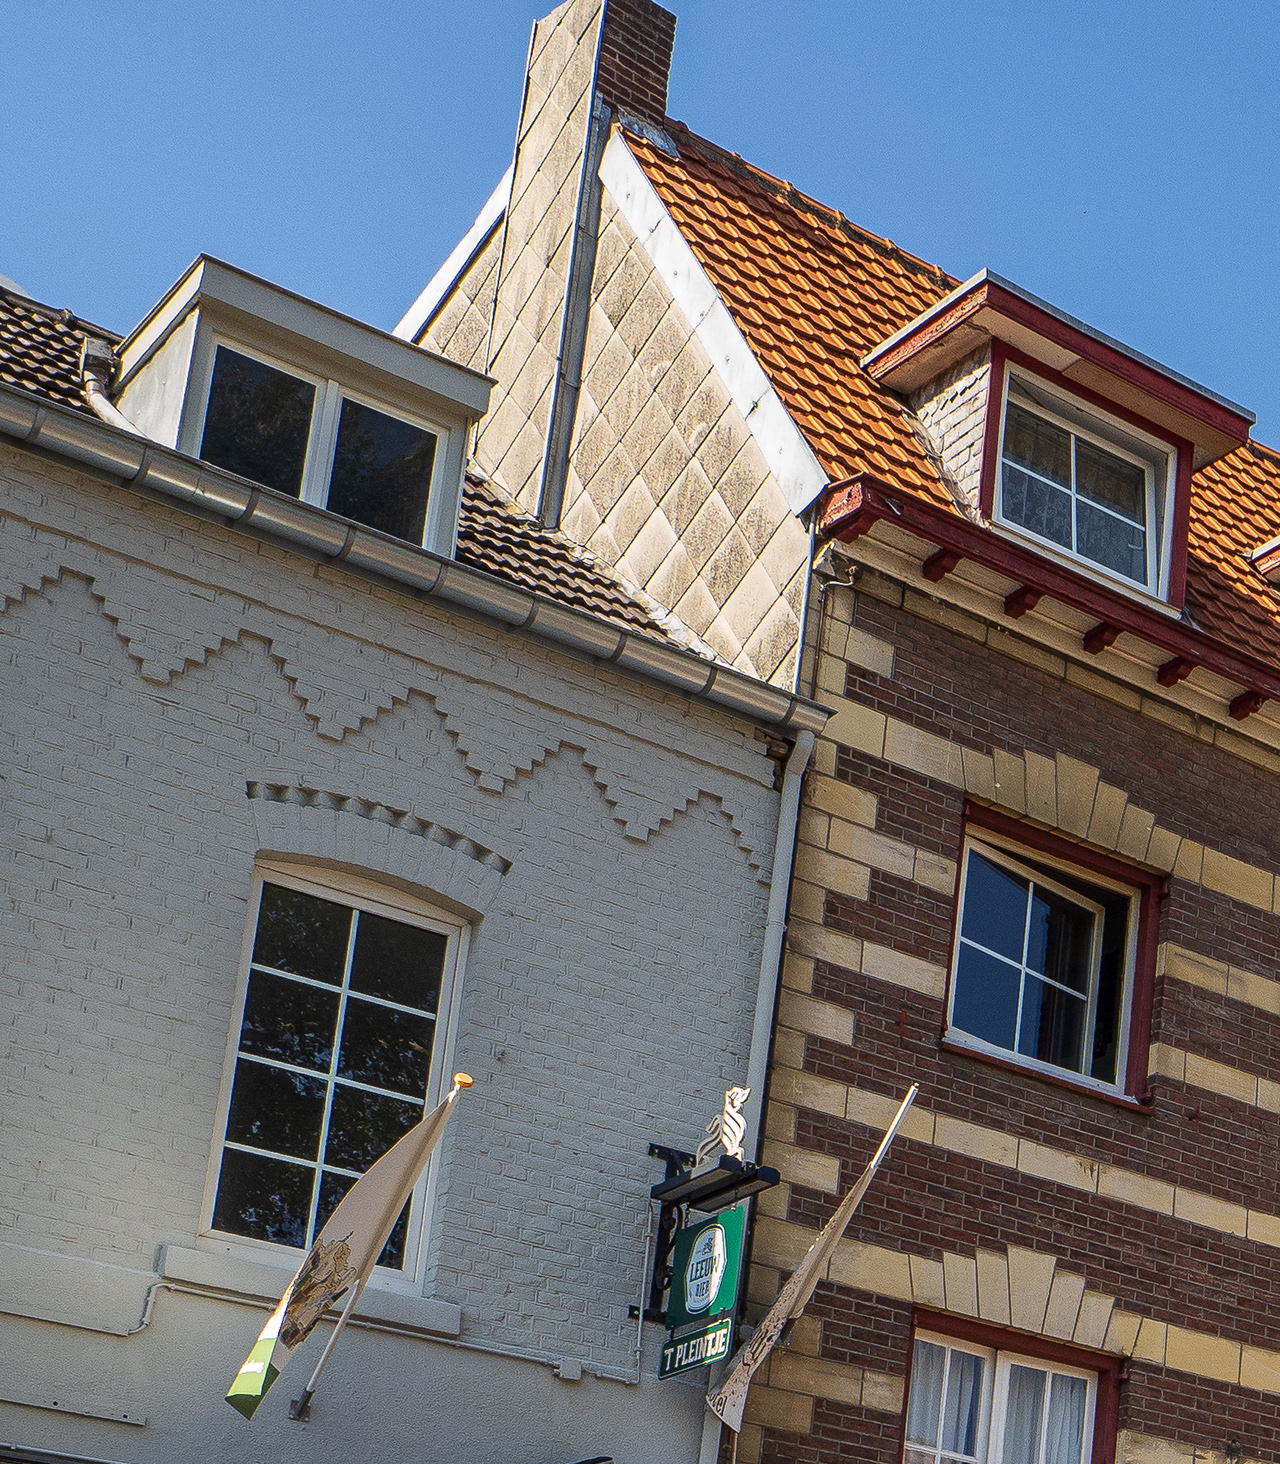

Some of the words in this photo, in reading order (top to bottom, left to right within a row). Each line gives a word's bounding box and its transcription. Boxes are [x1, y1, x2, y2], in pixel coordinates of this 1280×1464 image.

[689, 1253, 721, 1283] LEEUW
[695, 1280, 711, 1298] BIER
[674, 1328, 728, 1368] PLEINTJE
